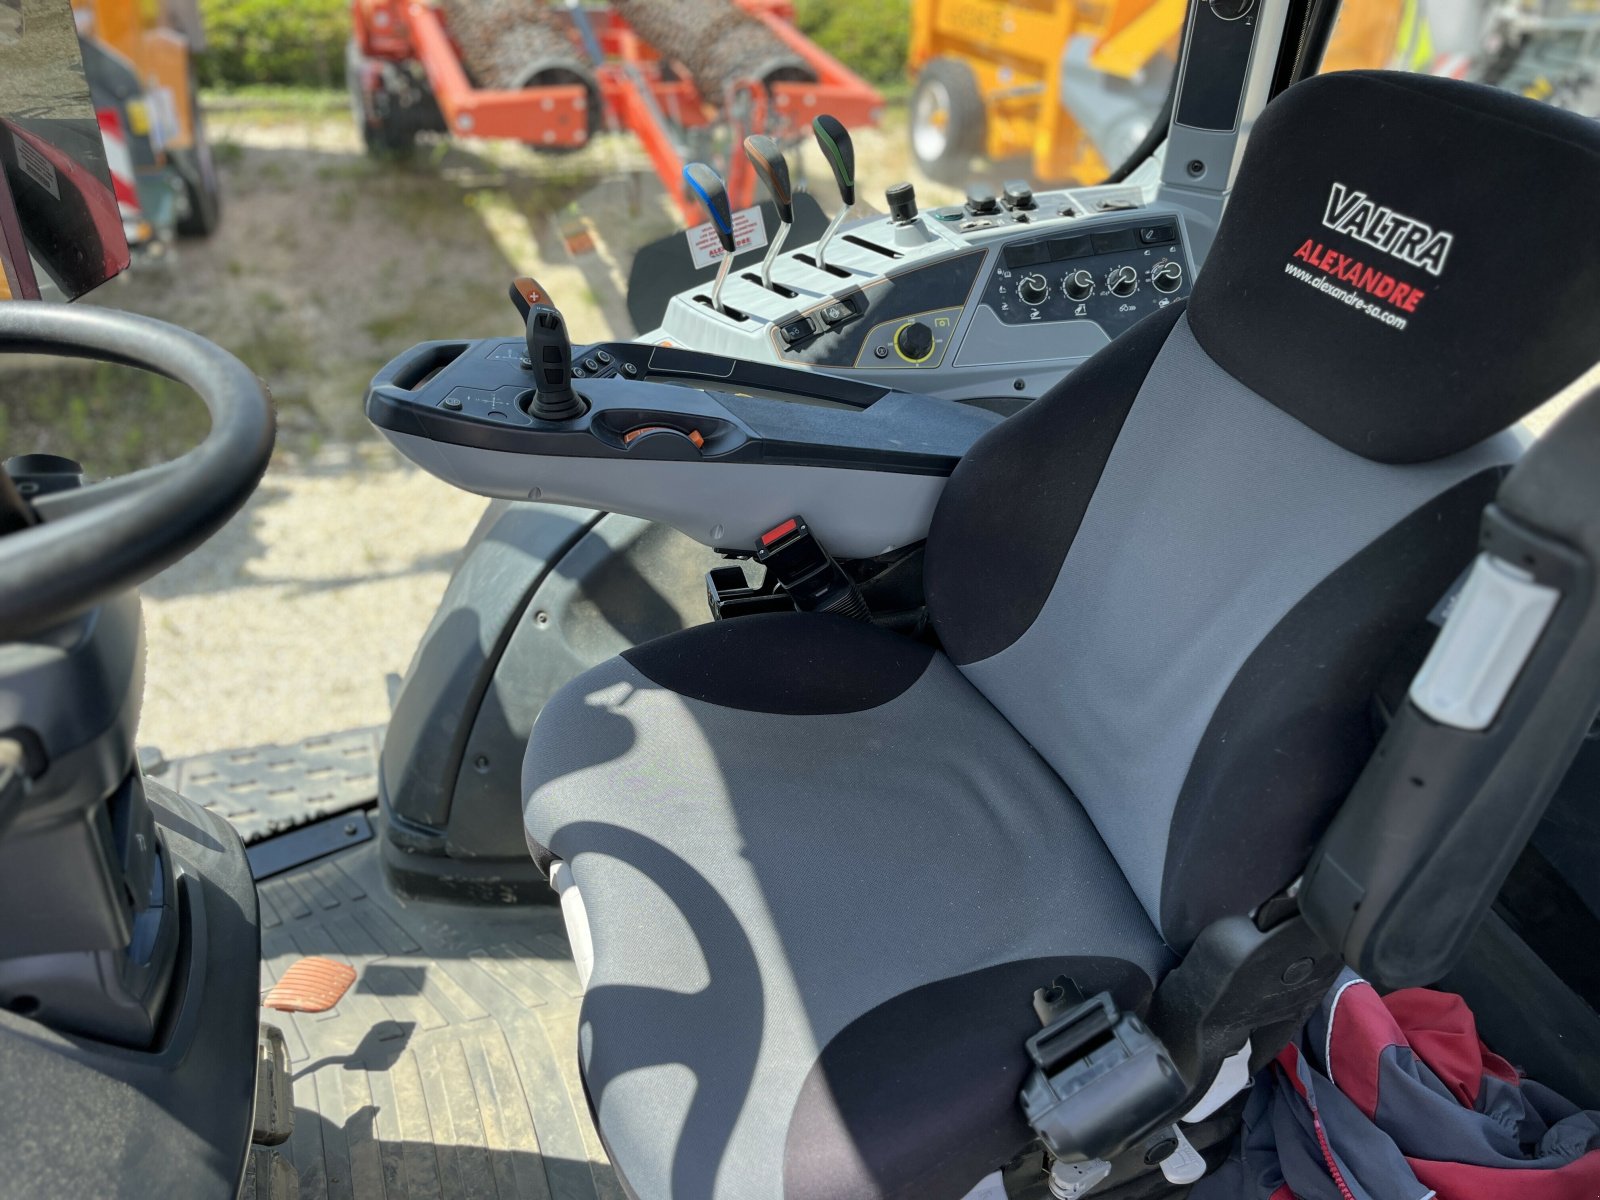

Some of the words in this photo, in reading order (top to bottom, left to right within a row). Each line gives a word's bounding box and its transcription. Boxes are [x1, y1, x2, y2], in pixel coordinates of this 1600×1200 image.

[1321, 181, 1455, 277] VALTRA
[1284, 262, 1408, 331] www.alexandre-sa.com
[1293, 239, 1425, 313] ALEXANDRE
